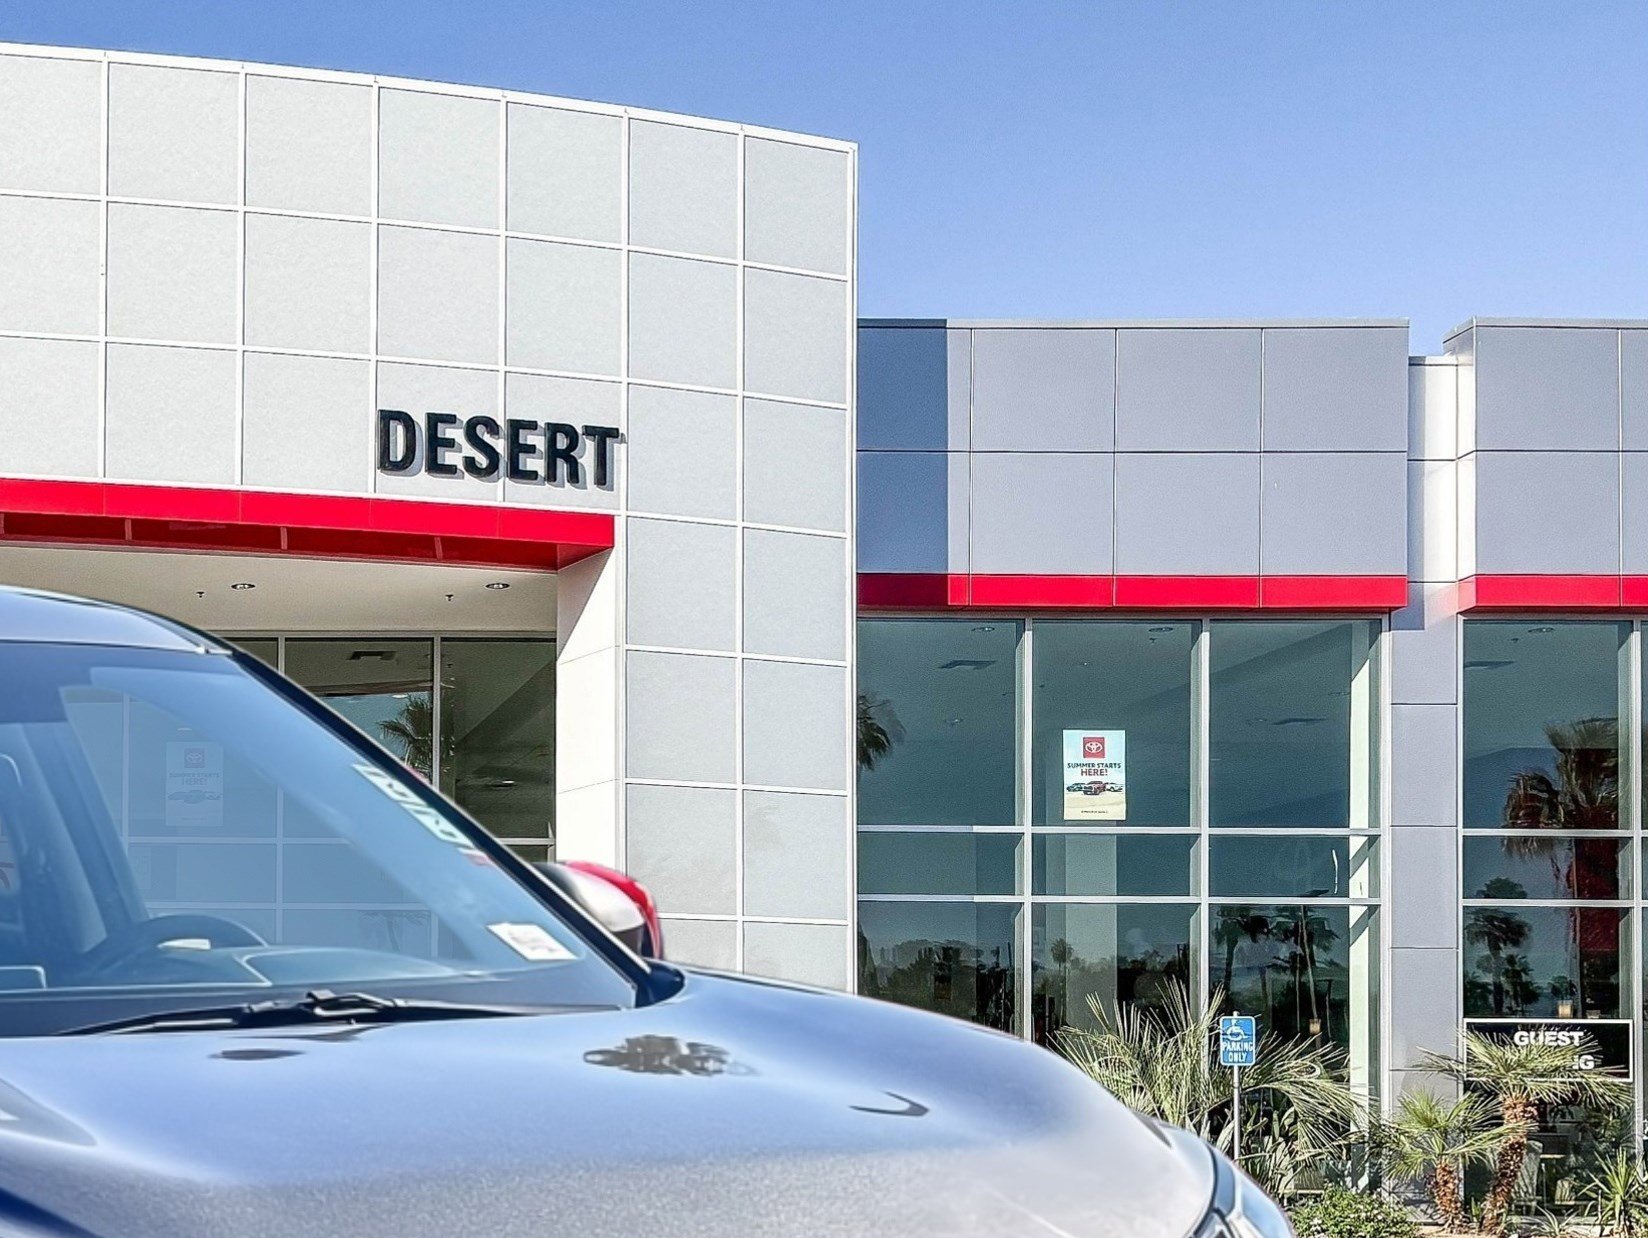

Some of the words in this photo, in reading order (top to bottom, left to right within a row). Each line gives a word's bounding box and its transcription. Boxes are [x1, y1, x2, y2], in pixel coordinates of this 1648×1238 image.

[377, 409, 620, 487] DESERT
[1080, 768, 1108, 776] HERE!
[1513, 1031, 1585, 1046] GUEST
[1221, 1041, 1254, 1051] PARKING
[1228, 1052, 1248, 1062] ONLY
